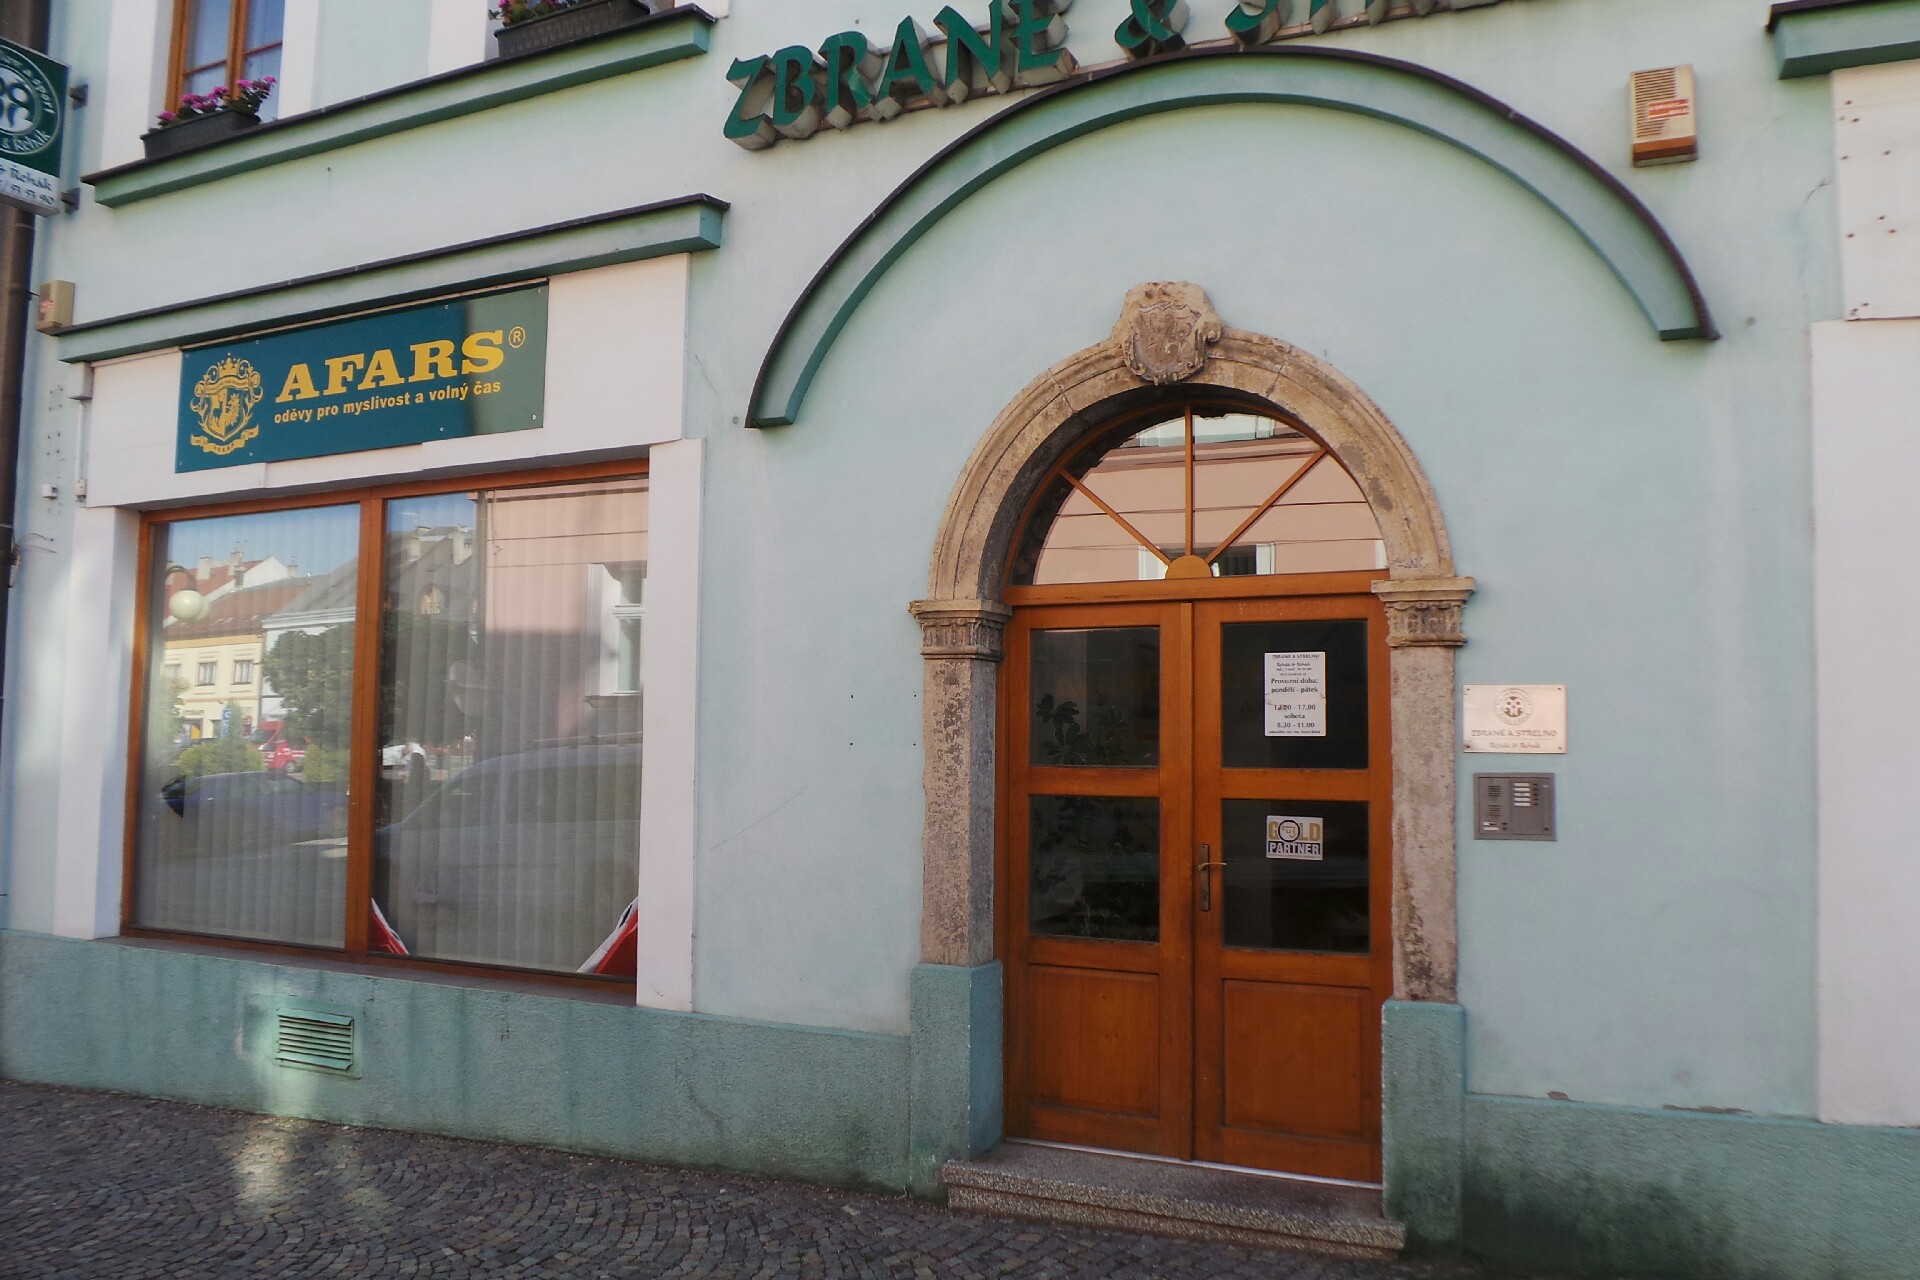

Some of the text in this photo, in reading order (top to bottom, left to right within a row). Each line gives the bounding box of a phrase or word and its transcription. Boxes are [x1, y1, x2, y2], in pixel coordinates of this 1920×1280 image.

[275, 329, 506, 404] AFARS
[274, 379, 502, 424] oděvy pro myslivost a volný čas
[1269, 842, 1320, 855] PARTNER
